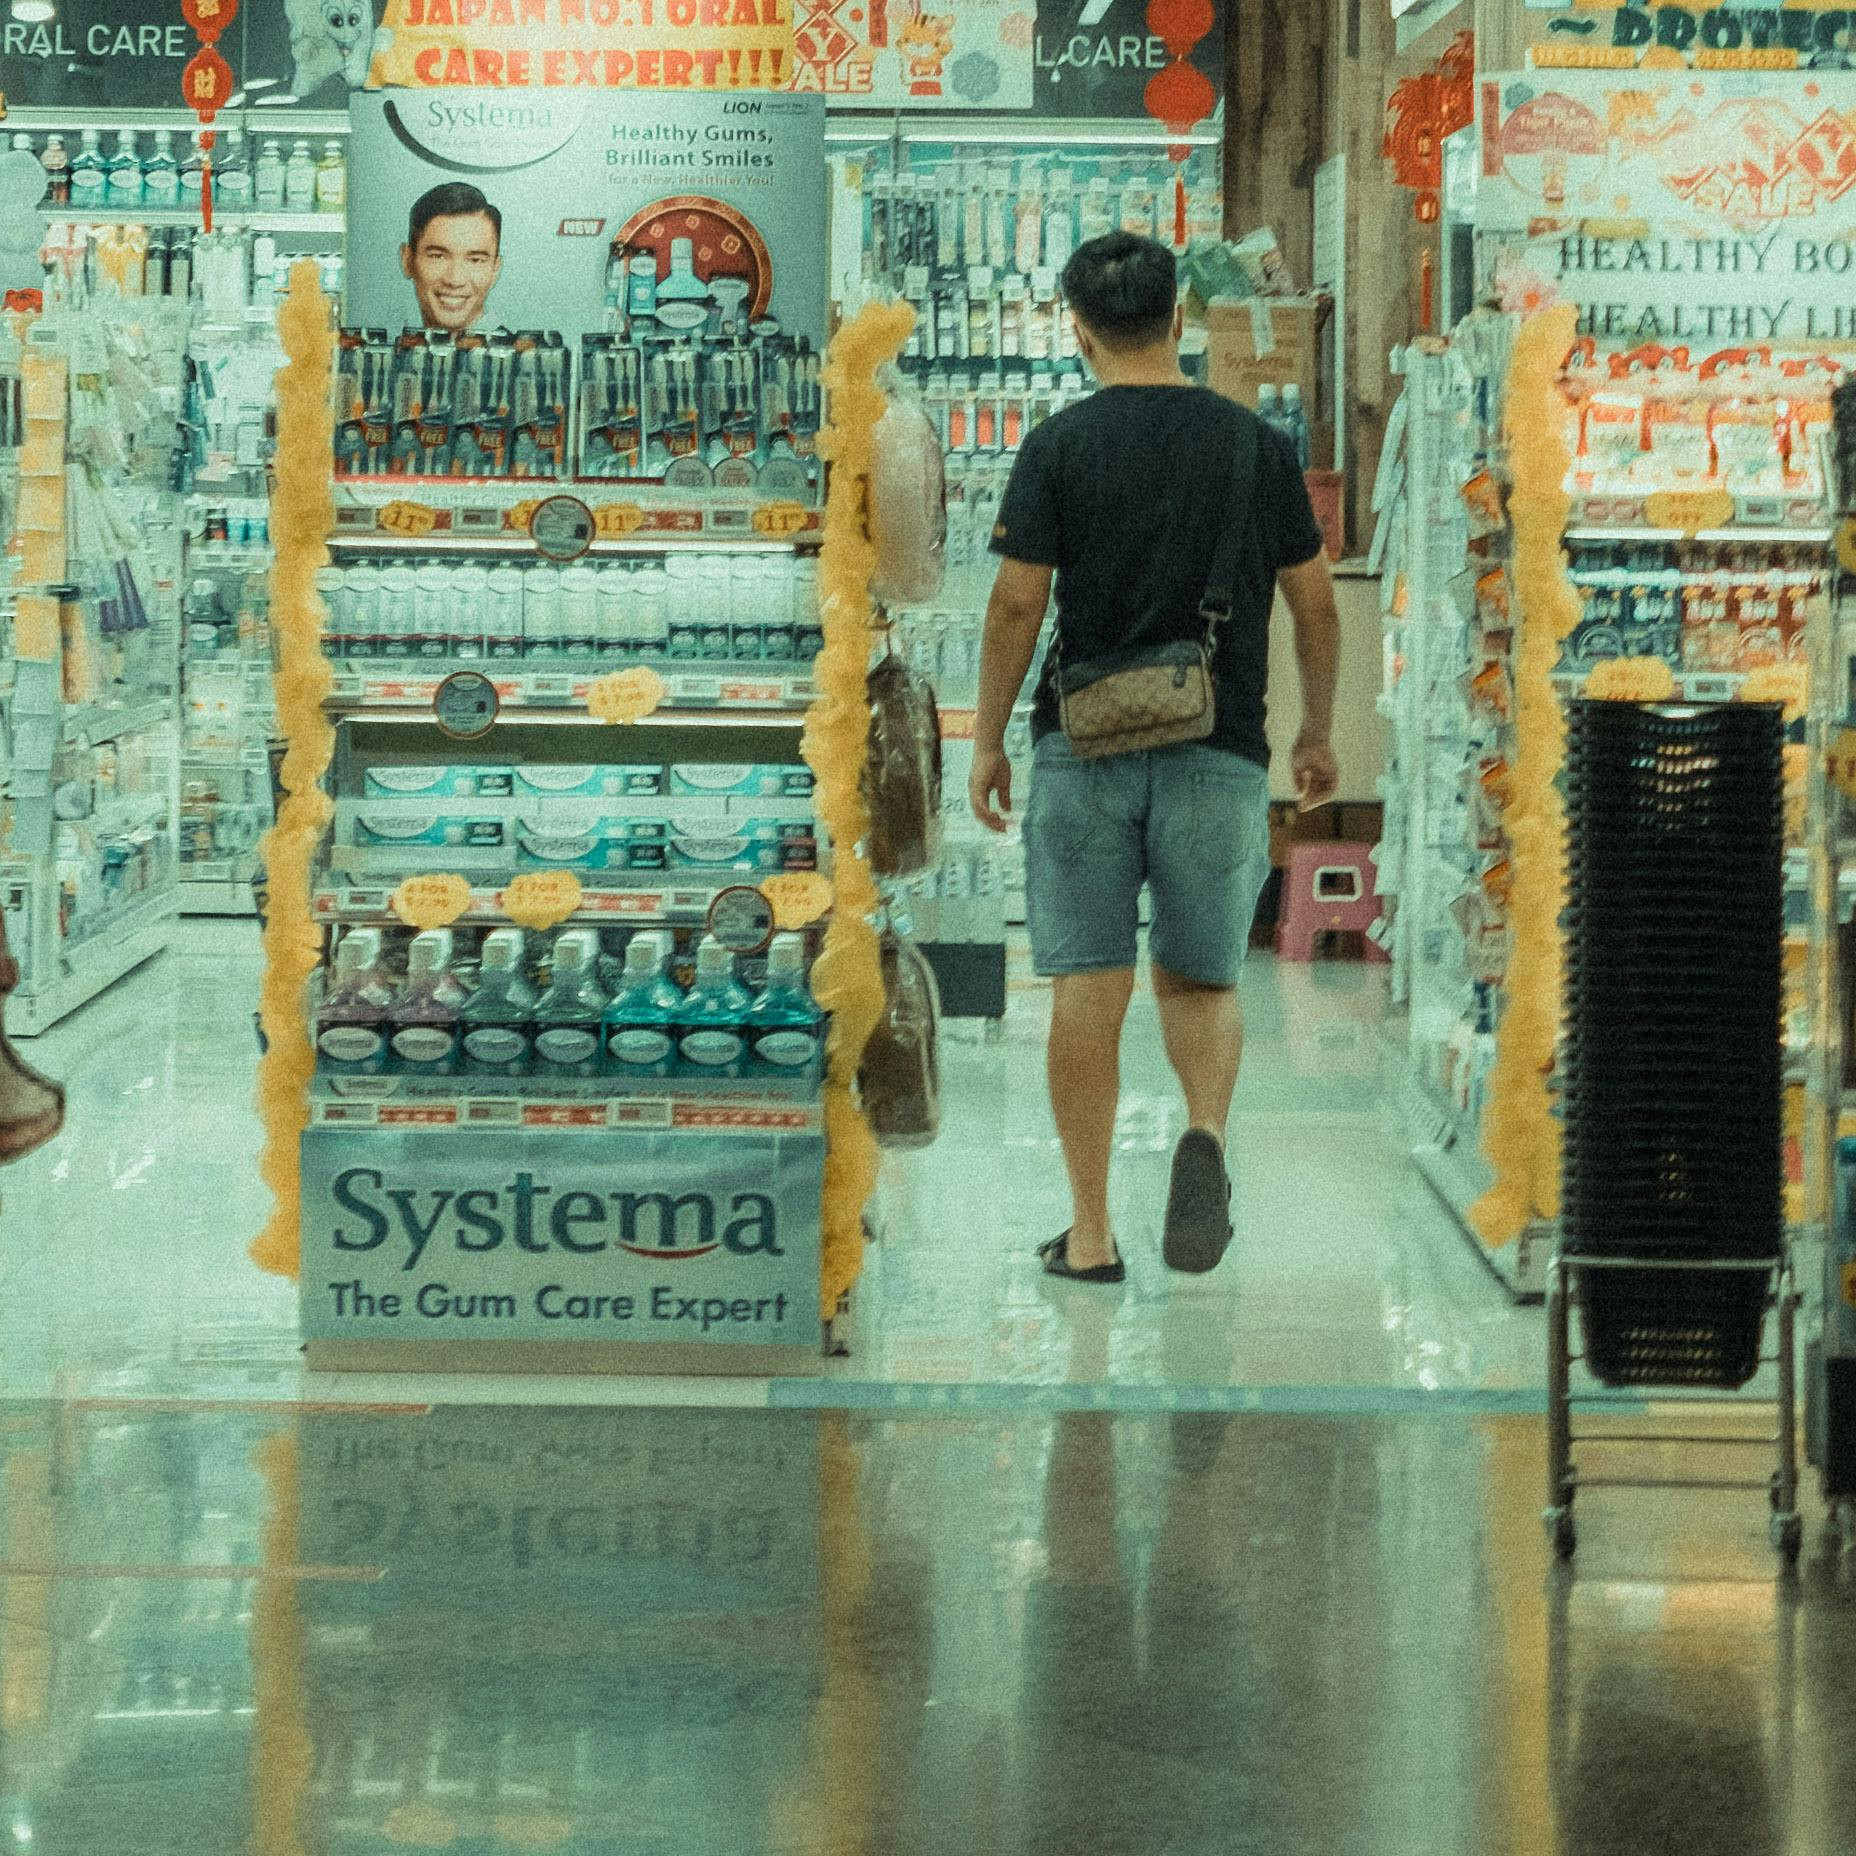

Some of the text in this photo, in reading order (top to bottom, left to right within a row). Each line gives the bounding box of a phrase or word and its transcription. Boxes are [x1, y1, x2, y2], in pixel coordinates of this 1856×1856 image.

[87, 22, 187, 58] CARE
[1067, 34, 1172, 70] CARE
[415, 49, 783, 88] CARE EXPERT!!!
[427, 100, 554, 134] Systema
[722, 100, 763, 115] LION
[611, 124, 774, 145] Healthy Gums,
[606, 150, 774, 168] Brilliant Smiles
[1556, 234, 1780, 278] HEALTHY
[331, 1166, 787, 1271] Systema
[328, 1279, 788, 1332] The Gum Care Expert
